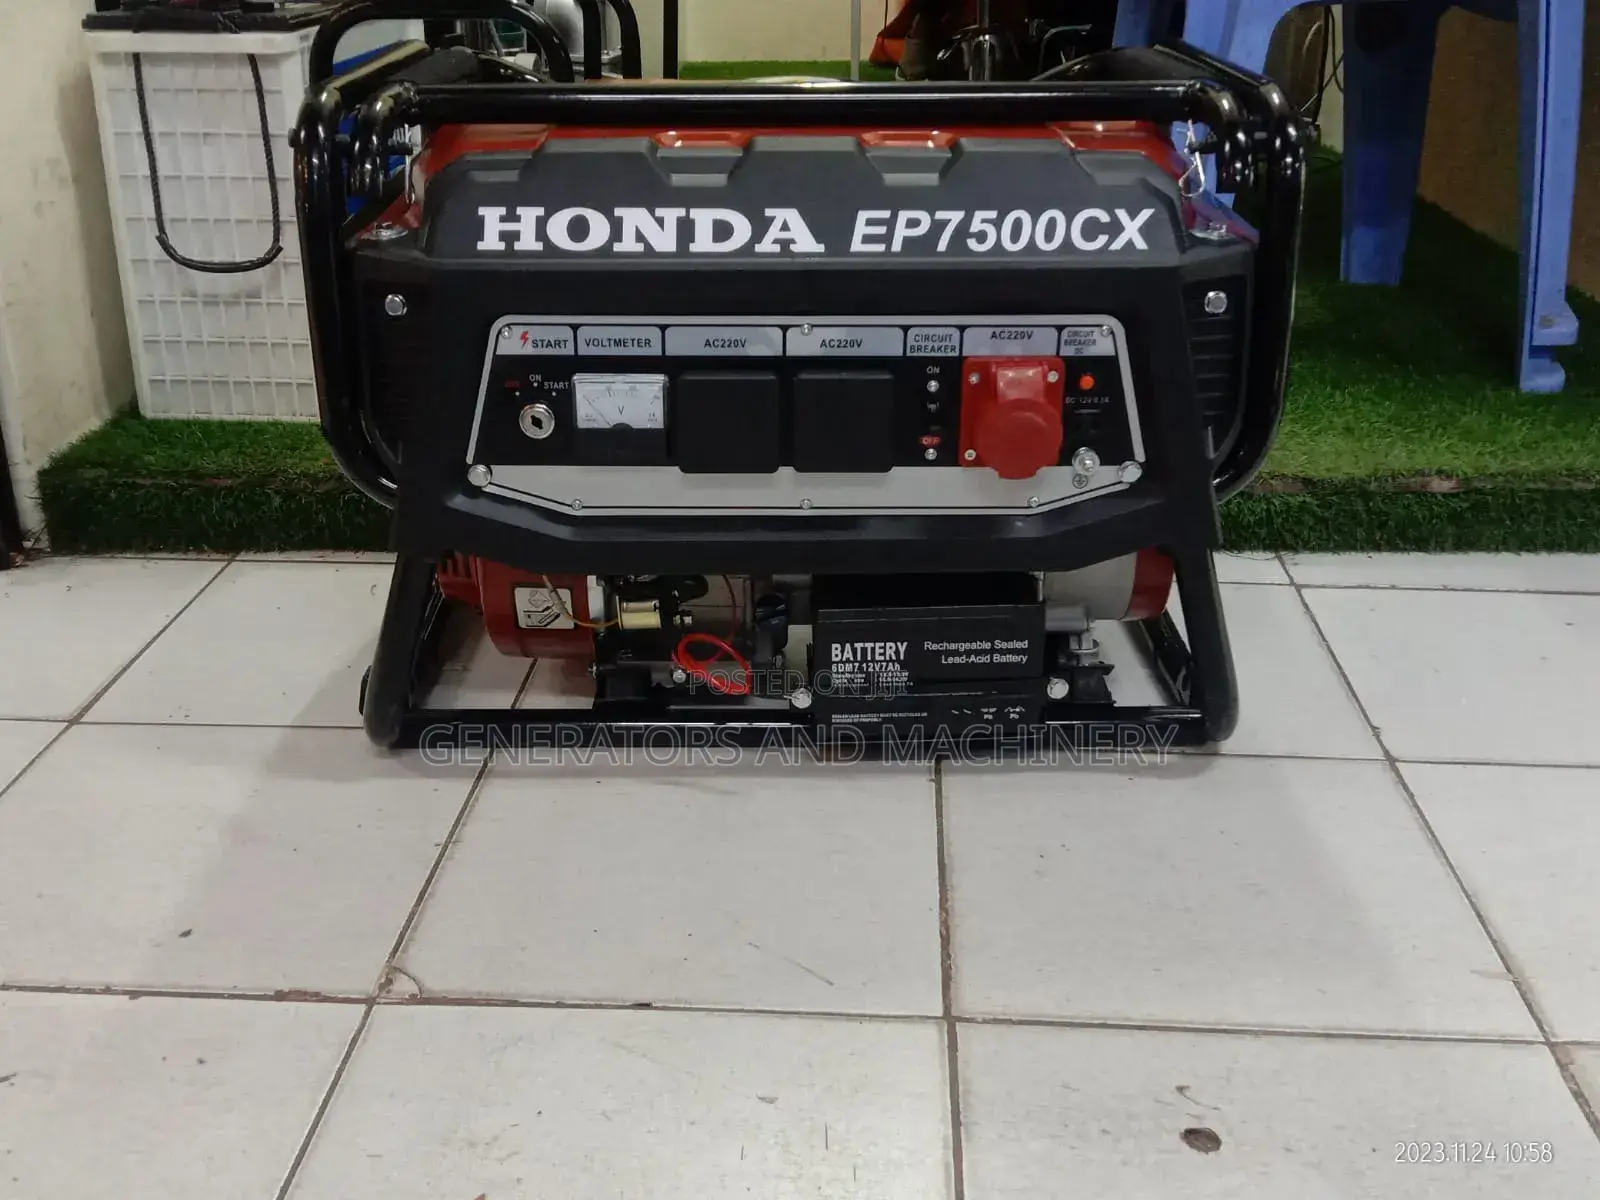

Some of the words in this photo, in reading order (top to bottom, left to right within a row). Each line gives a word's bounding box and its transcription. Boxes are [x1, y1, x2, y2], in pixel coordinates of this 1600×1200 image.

[476, 206, 826, 253] HONDA
[850, 208, 1155, 252] EP7500CX
[914, 333, 953, 343] CIRCUIT
[990, 331, 1034, 341] AC220V
[532, 339, 569, 350] START
[584, 338, 652, 349] VOLTMETER
[704, 338, 747, 349] AC220V
[819, 339, 863, 349] AC220V
[909, 344, 957, 354] BREAKER
[926, 365, 940, 374] ON
[529, 374, 542, 382] ON
[543, 382, 570, 390] START
[617, 405, 625, 416] V
[924, 641, 992, 652] Rechargeable
[994, 640, 1028, 649] Sealed
[831, 641, 909, 662] BATTERY
[942, 654, 990, 664] Lead-Acid
[993, 654, 1028, 664] Battery
[862, 662, 901, 672] 12V7Ah
